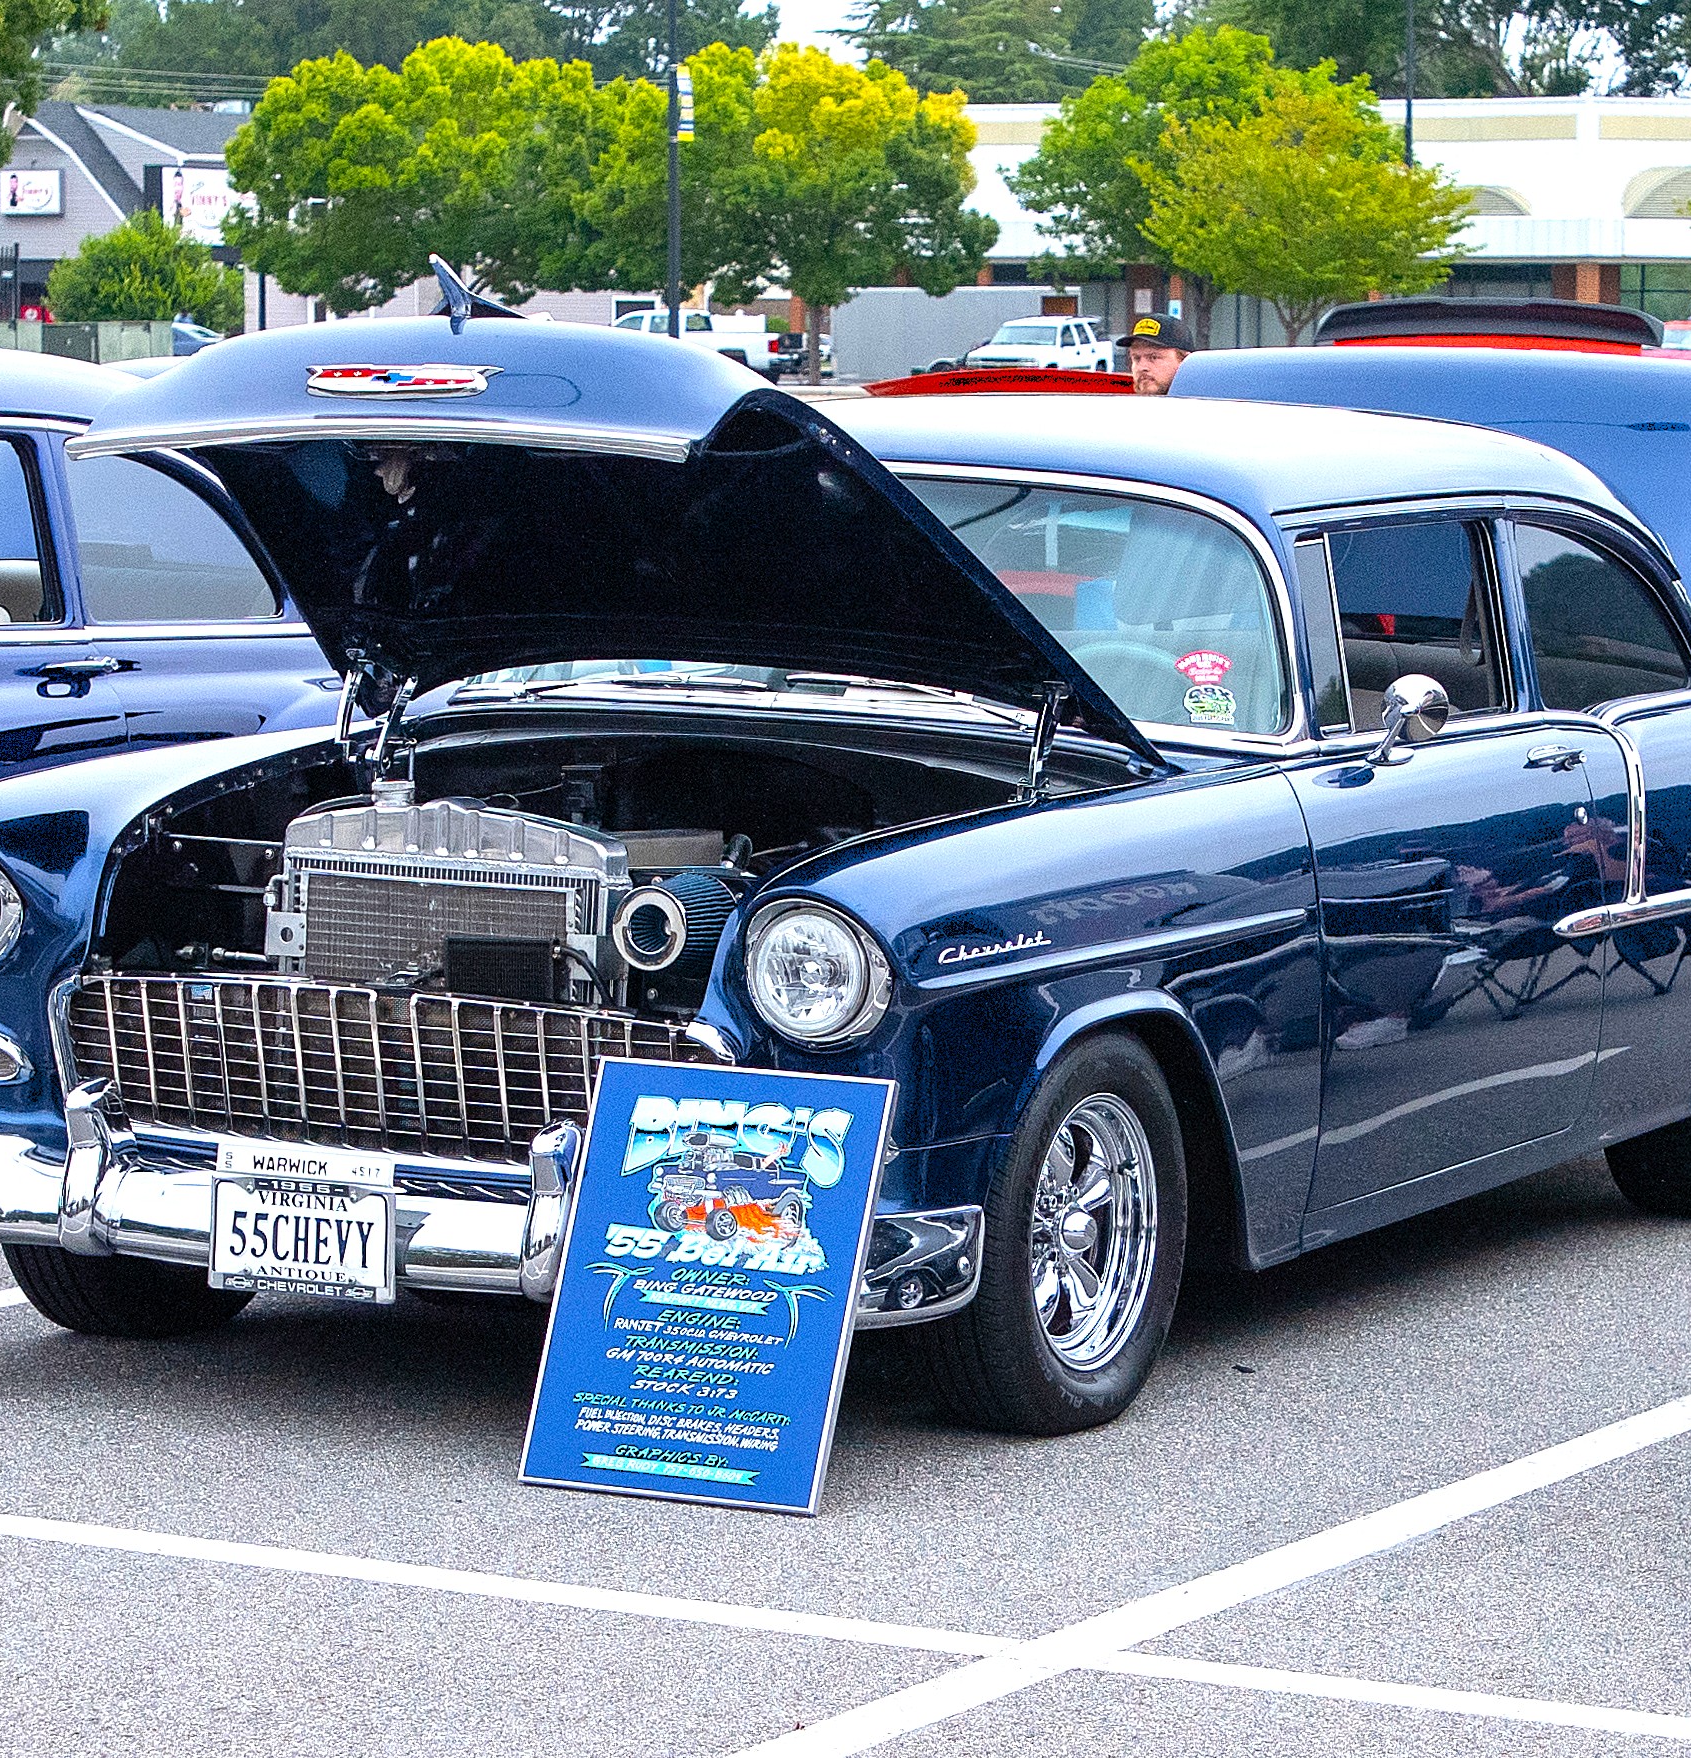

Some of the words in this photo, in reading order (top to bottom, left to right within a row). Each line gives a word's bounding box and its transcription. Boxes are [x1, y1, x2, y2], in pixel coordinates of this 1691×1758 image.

[937, 930, 1052, 965] Chevrolet
[621, 1095, 854, 1189] BING'S
[253, 1154, 328, 1177] WARWICK
[258, 1190, 348, 1213] VIRGINIA
[229, 1210, 375, 1269] 55CHEVY
[666, 1232, 740, 1268] Bel
[742, 1243, 819, 1276] Air
[256, 1265, 347, 1283] ANTIQUE
[671, 1268, 750, 1286] OWNER:
[257, 1280, 343, 1297] CHEVROLET
[633, 1279, 678, 1294] BING
[681, 1283, 778, 1302] GATEWOOD
[657, 1309, 741, 1329] ENGINE:
[614, 1317, 664, 1333] RAMJET
[708, 1329, 784, 1346] CHEVROLET
[624, 1335, 760, 1360] TRANSMISSION:
[606, 1347, 636, 1362] GM
[637, 1350, 684, 1366] 700R4
[685, 1355, 775, 1375] AUTOMATIC
[633, 1364, 739, 1386] REAREND:
[630, 1379, 695, 1395] STOCK
[572, 1392, 630, 1408] SPECIAL
[631, 1398, 686, 1415] THANKS
[688, 1405, 705, 1415] TO
[578, 1406, 603, 1419] FUEL
[647, 1414, 677, 1427] DISC
[574, 1419, 610, 1433] POWER
[739, 1437, 779, 1453] WIRING
[591, 1455, 624, 1468] GREG
[614, 1444, 703, 1465] GRAPHICS
[704, 1453, 729, 1469] BY:
